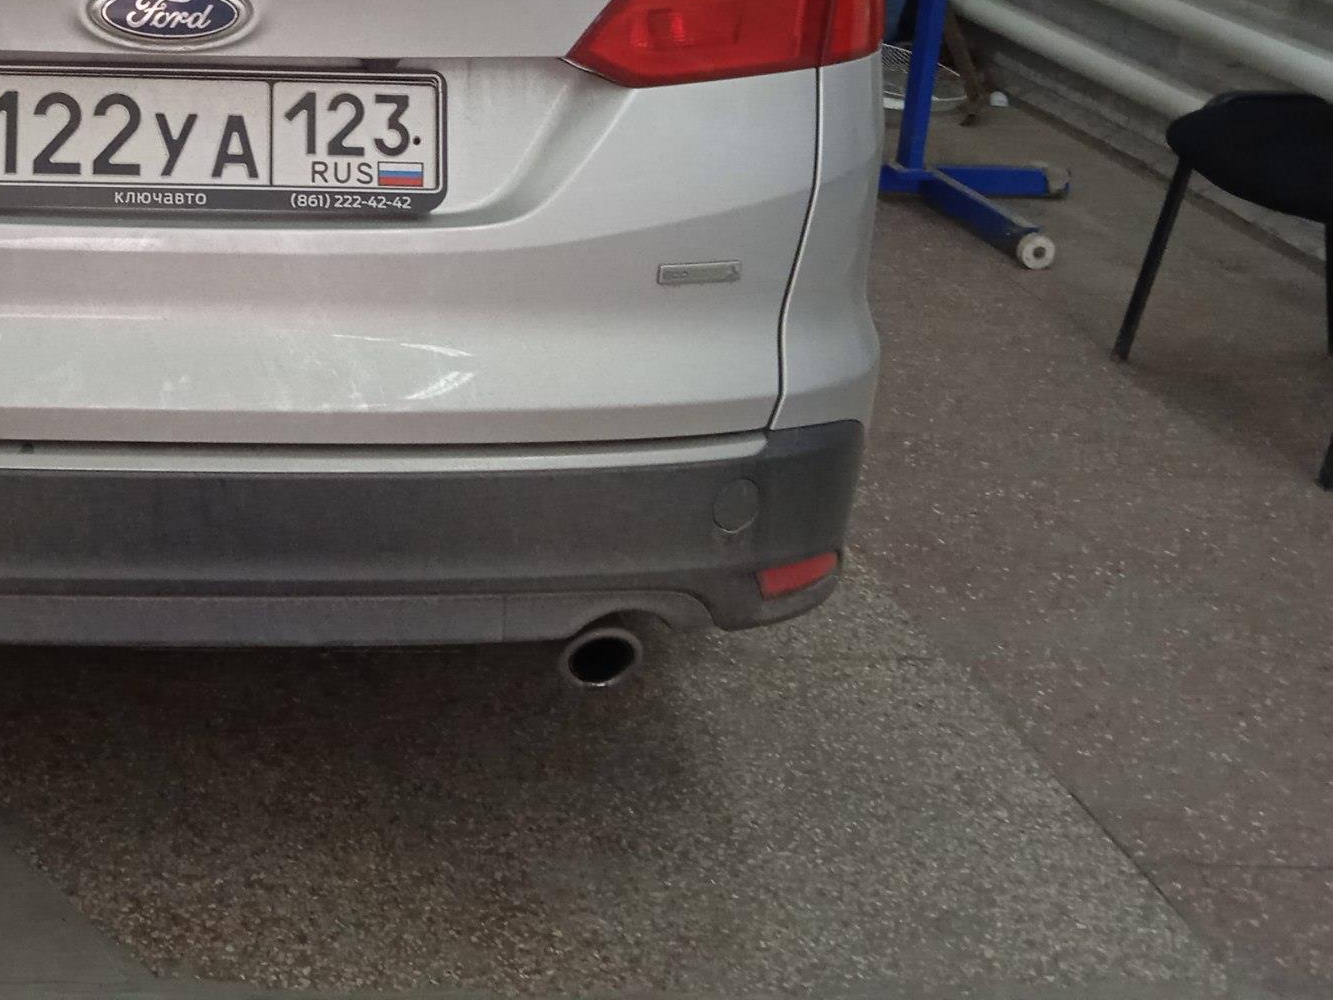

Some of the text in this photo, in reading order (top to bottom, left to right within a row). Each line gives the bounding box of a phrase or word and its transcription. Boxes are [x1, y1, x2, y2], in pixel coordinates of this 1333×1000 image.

[283, 91, 411, 157] 123
[311, 161, 374, 184] RUS
[290, 193, 412, 210] (861) 222-42-42
